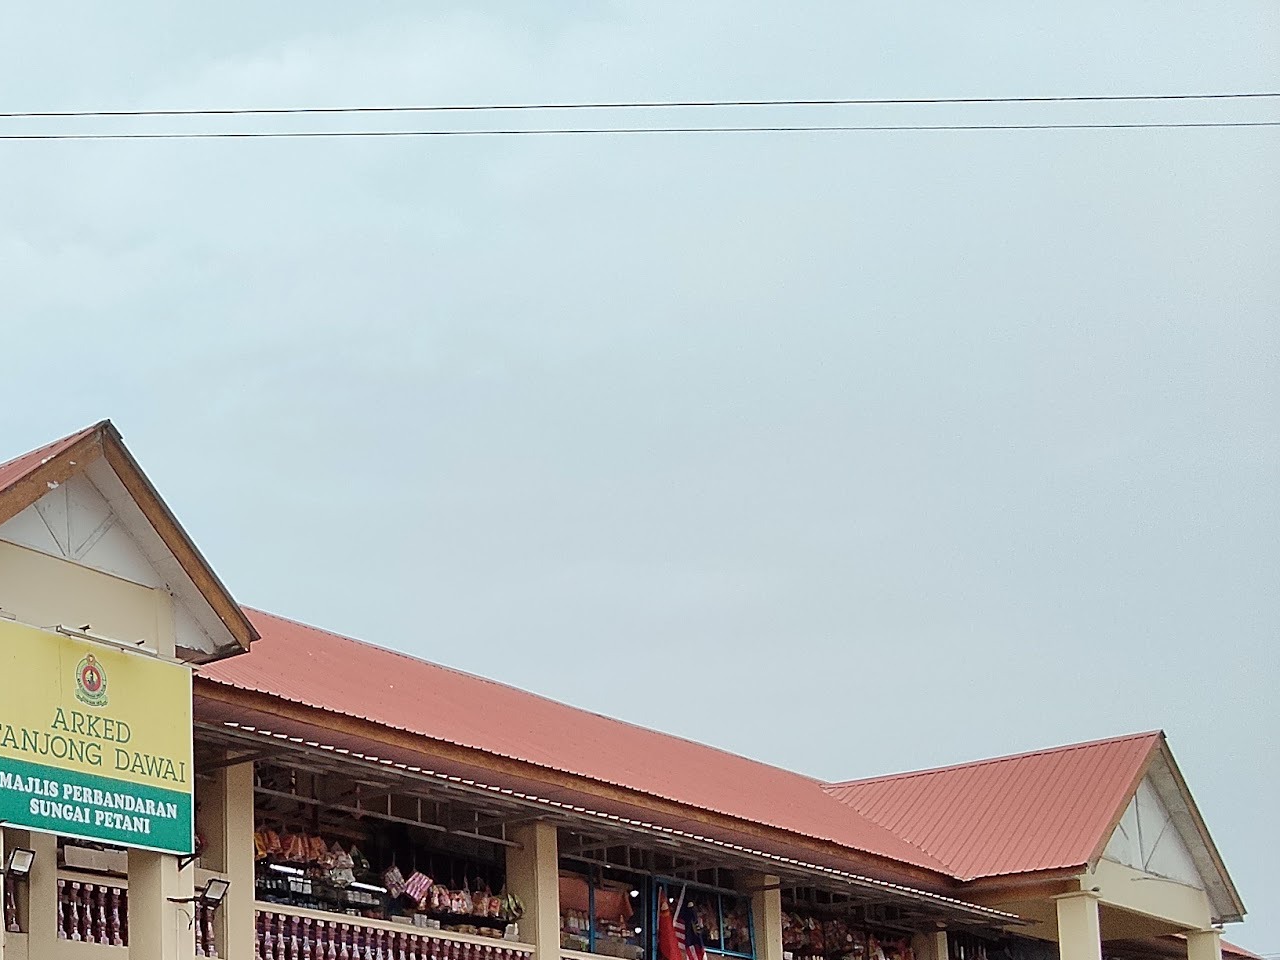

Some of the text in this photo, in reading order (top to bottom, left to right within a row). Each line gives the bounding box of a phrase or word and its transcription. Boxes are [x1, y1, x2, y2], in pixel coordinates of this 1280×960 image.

[51, 707, 131, 744] ARKED
[115, 748, 186, 783] DAWAI
[0, 771, 177, 819] MAJLIS PERBANDARAN
[29, 798, 150, 834] SUNGAI PETANI
